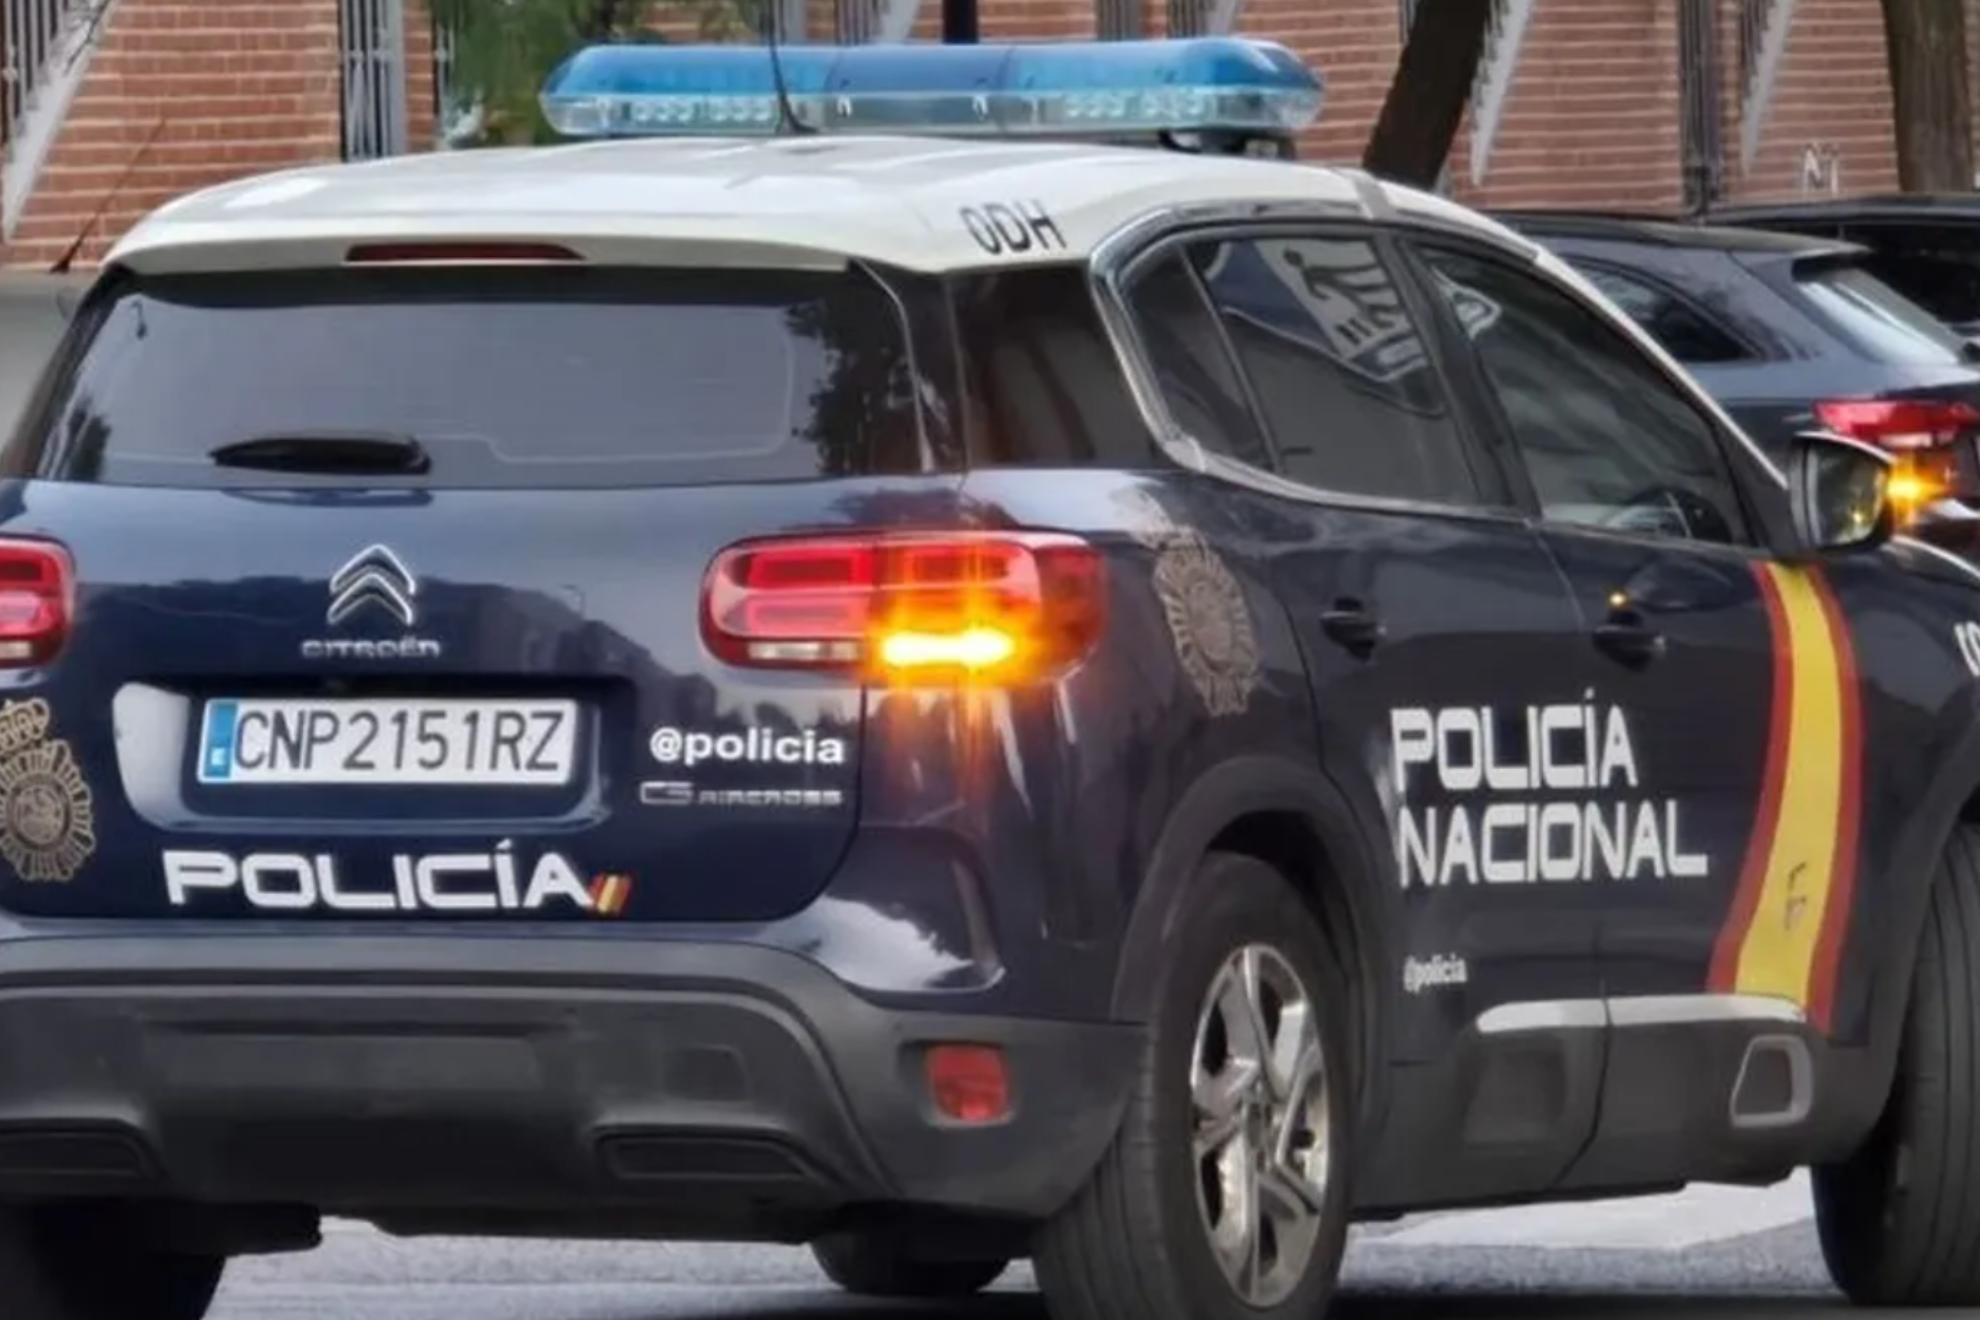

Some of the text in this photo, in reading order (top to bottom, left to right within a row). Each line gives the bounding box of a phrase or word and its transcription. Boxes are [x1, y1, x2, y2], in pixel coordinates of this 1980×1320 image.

[235, 710, 565, 771] CNP2151RZ
[649, 726, 845, 766] @policia
[1389, 687, 1638, 793] POLICÍA
[698, 789, 842, 805] AIRCROSS
[1398, 799, 1709, 888] NACIONAL
[163, 839, 594, 911] POLICÍA
[1403, 952, 1468, 993] @policia
